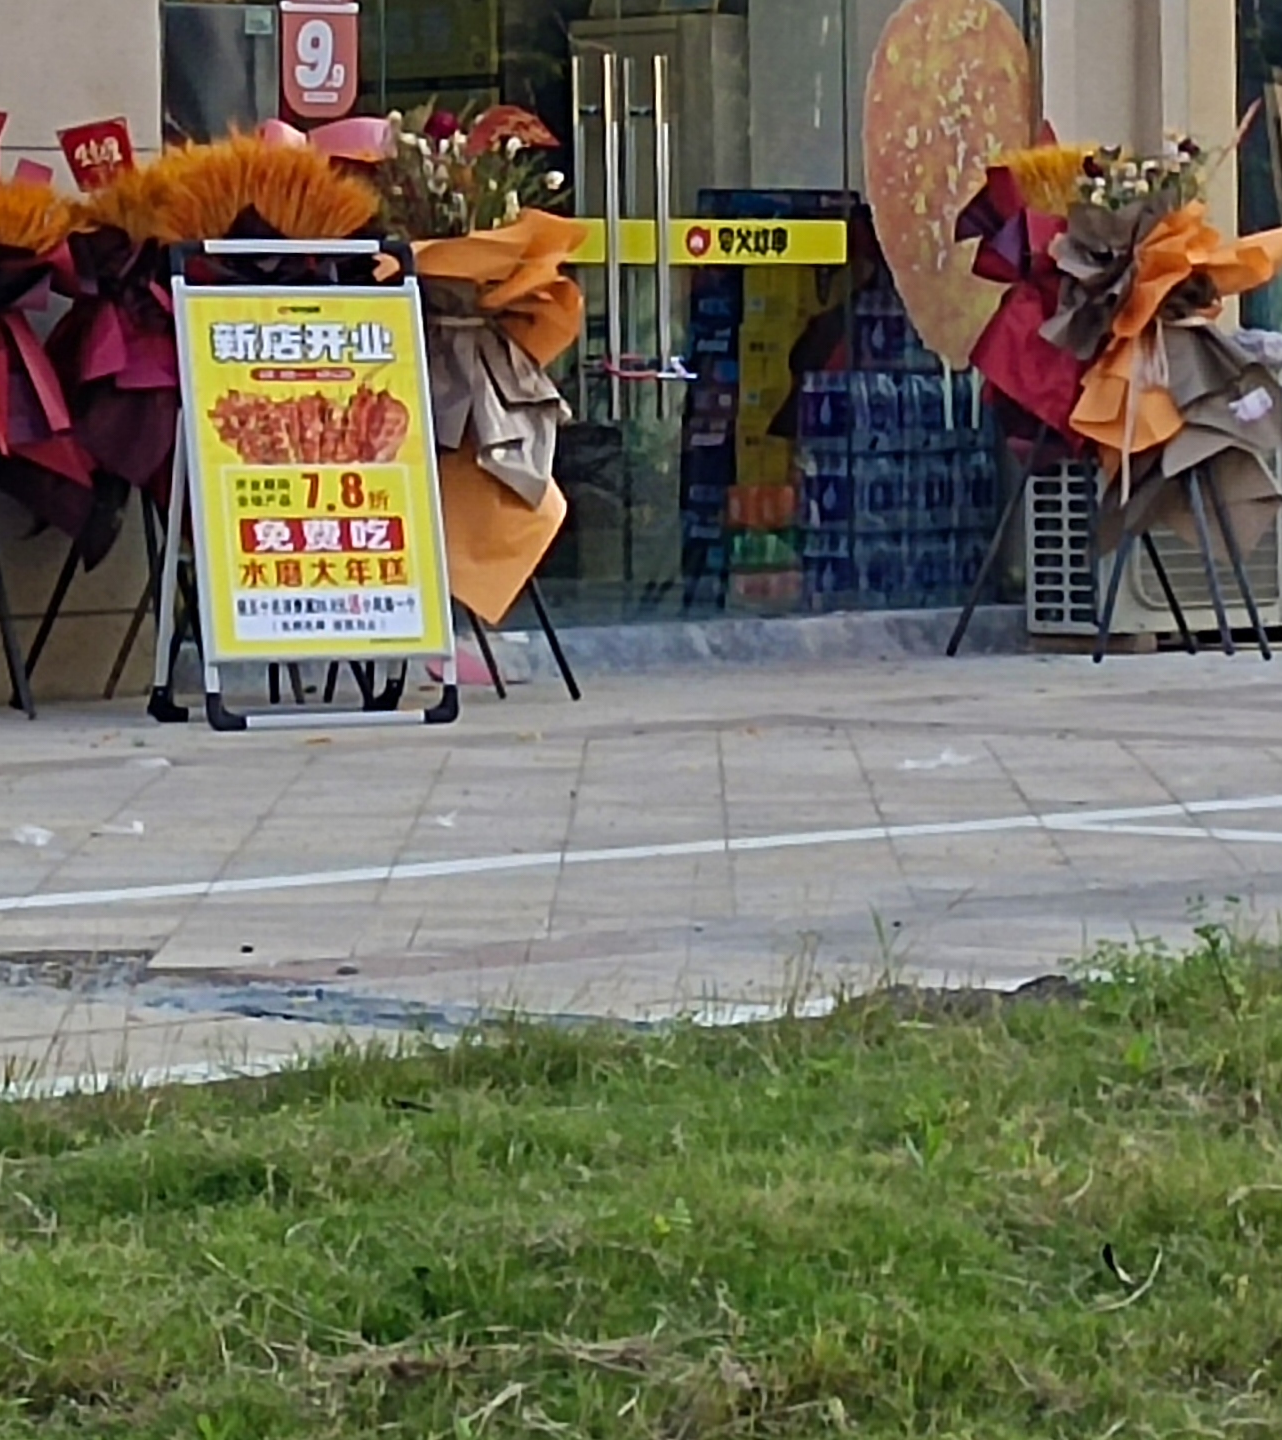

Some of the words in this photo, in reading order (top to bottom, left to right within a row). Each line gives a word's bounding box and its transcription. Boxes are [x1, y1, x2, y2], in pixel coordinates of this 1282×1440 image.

[210, 321, 397, 363] 新店开业
[252, 518, 392, 552] 免费吃
